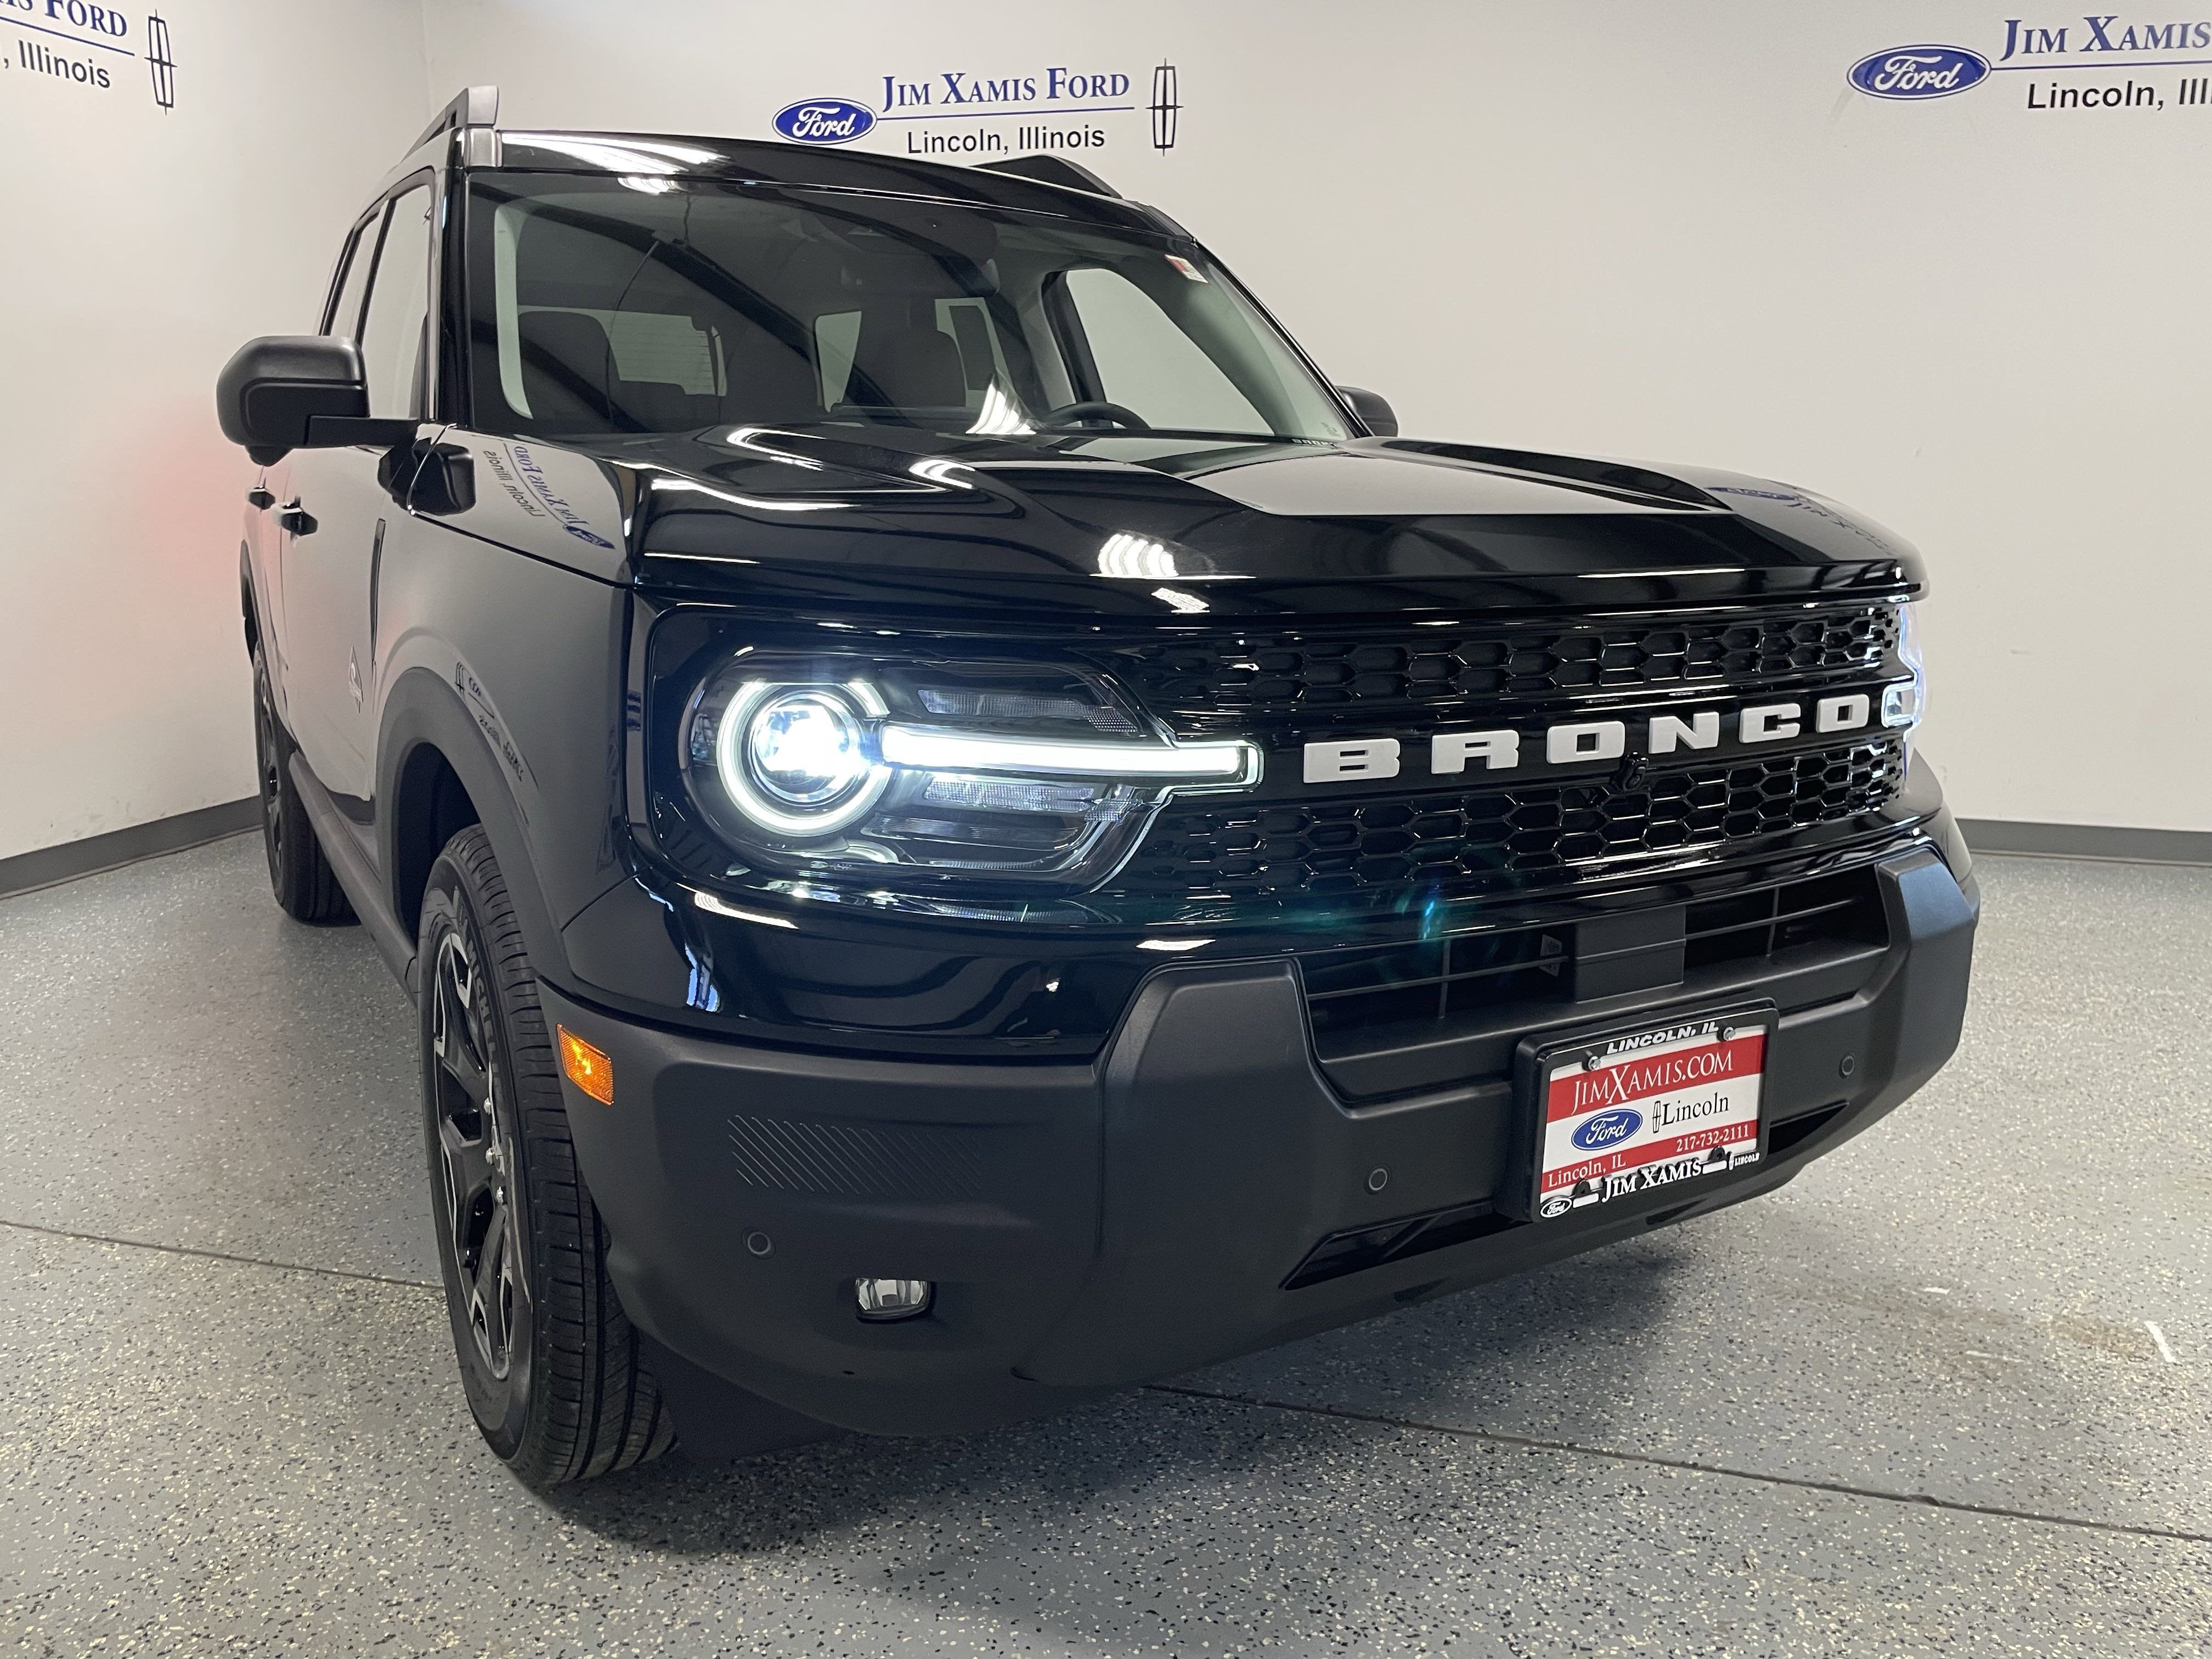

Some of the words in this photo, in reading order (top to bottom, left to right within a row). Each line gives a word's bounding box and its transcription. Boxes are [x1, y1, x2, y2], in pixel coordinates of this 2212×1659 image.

[2000, 20, 2069, 61] JIM
[2079, 16, 2211, 52] XAMIS
[18, 40, 110, 89] Illinois
[1874, 55, 1963, 91] Ford
[882, 76, 931, 112] JIM
[940, 72, 1036, 104] XAMIS
[1046, 67, 1130, 99] FORD
[2028, 81, 2164, 111] Lincoln,
[792, 107, 855, 137] Ford
[908, 128, 1009, 154] Lincoln,
[1019, 125, 1105, 149] Illinois
[1303, 694, 1870, 783] BRONCO
[1607, 1026, 1696, 1054] LINCOLN,
[1702, 1022, 1719, 1034] IL
[1662, 1092, 1729, 1126] Lincoln
[1585, 1117, 1627, 1145] Ford
[1676, 1124, 1749, 1153] 217-732-2111
[1548, 1160, 1606, 1188] Lincoln,
[1612, 1154, 1626, 1170] IL
[1601, 1176, 1637, 1203] JIM
[1640, 1160, 1701, 1190] XAMIS
